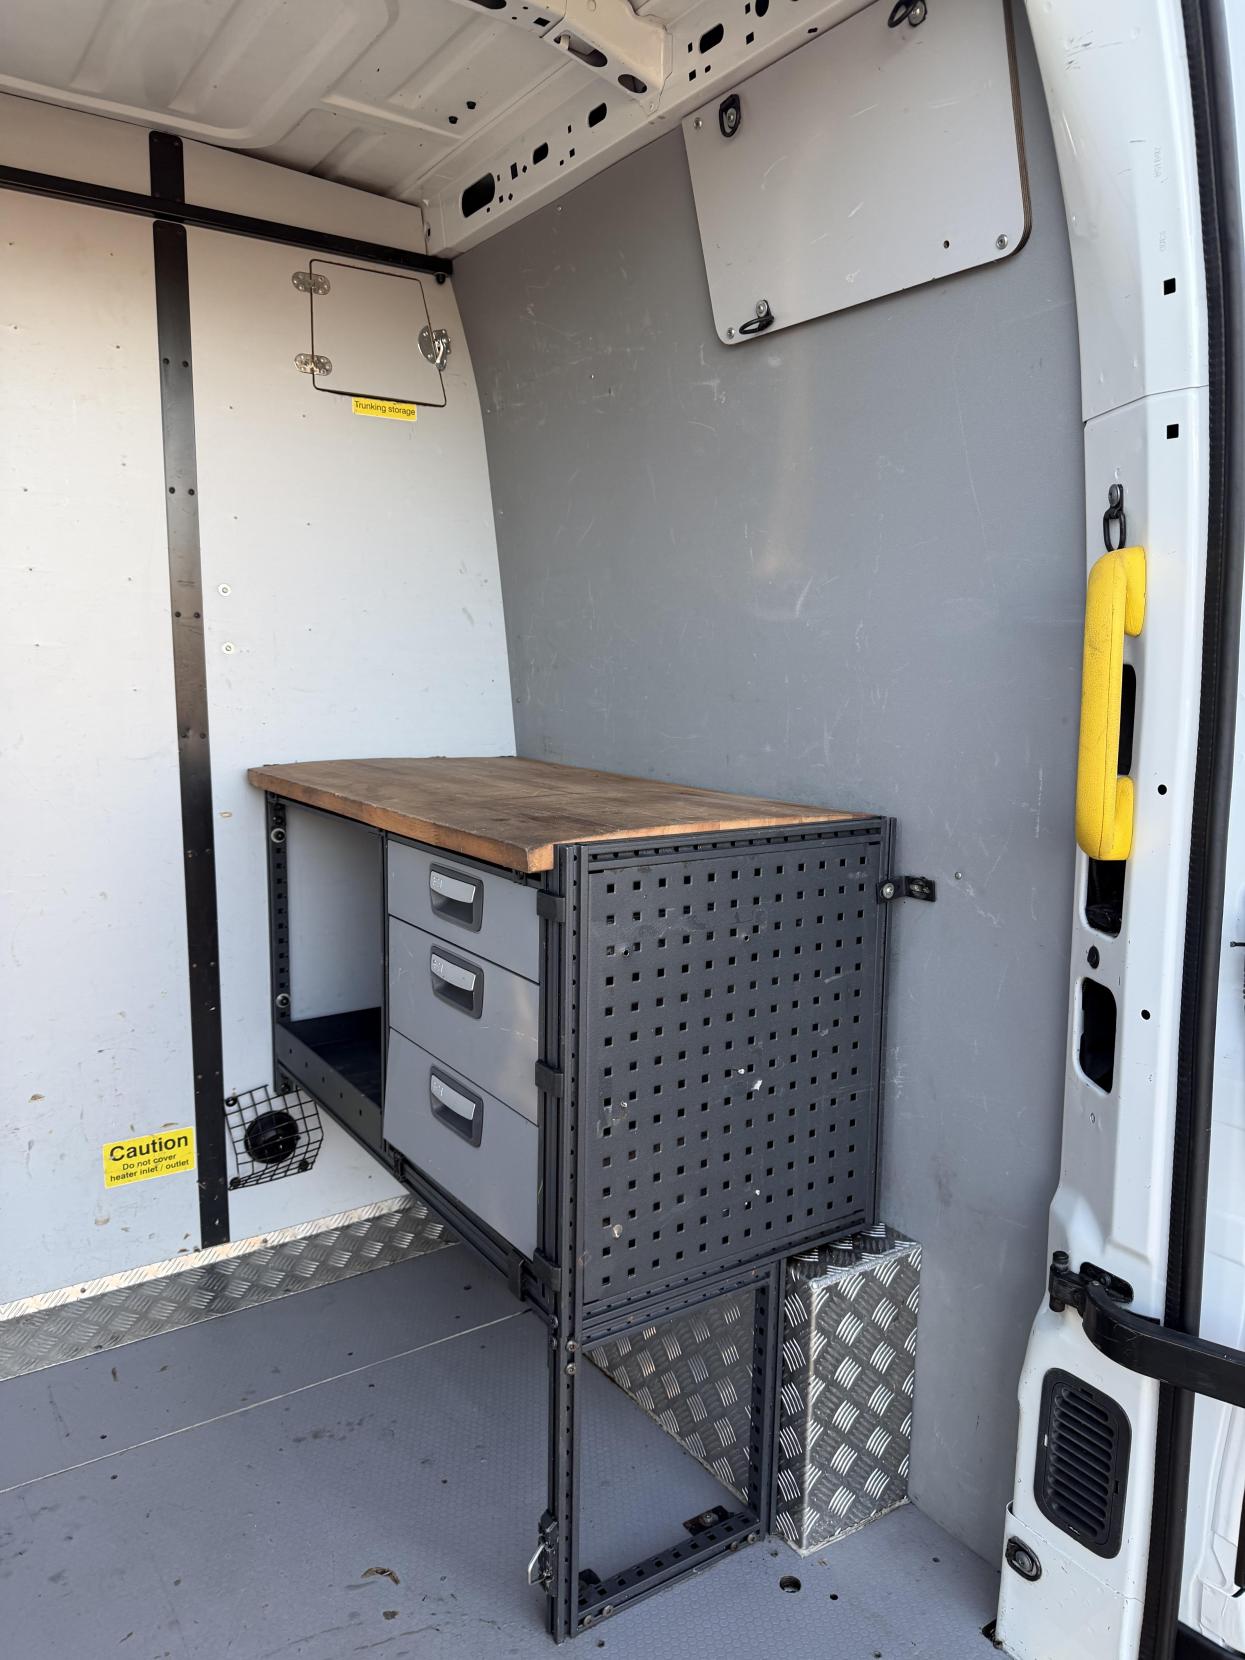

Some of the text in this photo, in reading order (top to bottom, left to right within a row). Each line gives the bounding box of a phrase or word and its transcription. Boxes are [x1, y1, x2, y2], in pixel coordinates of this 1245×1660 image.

[354, 400, 415, 416] Trunking storage
[109, 1135, 188, 1162] Caution
[110, 1171, 137, 1182] heater
[139, 1165, 158, 1175] inlet
[165, 1159, 189, 1169] outlet
[137, 1159, 150, 1168] not
[153, 1154, 176, 1164] cover
